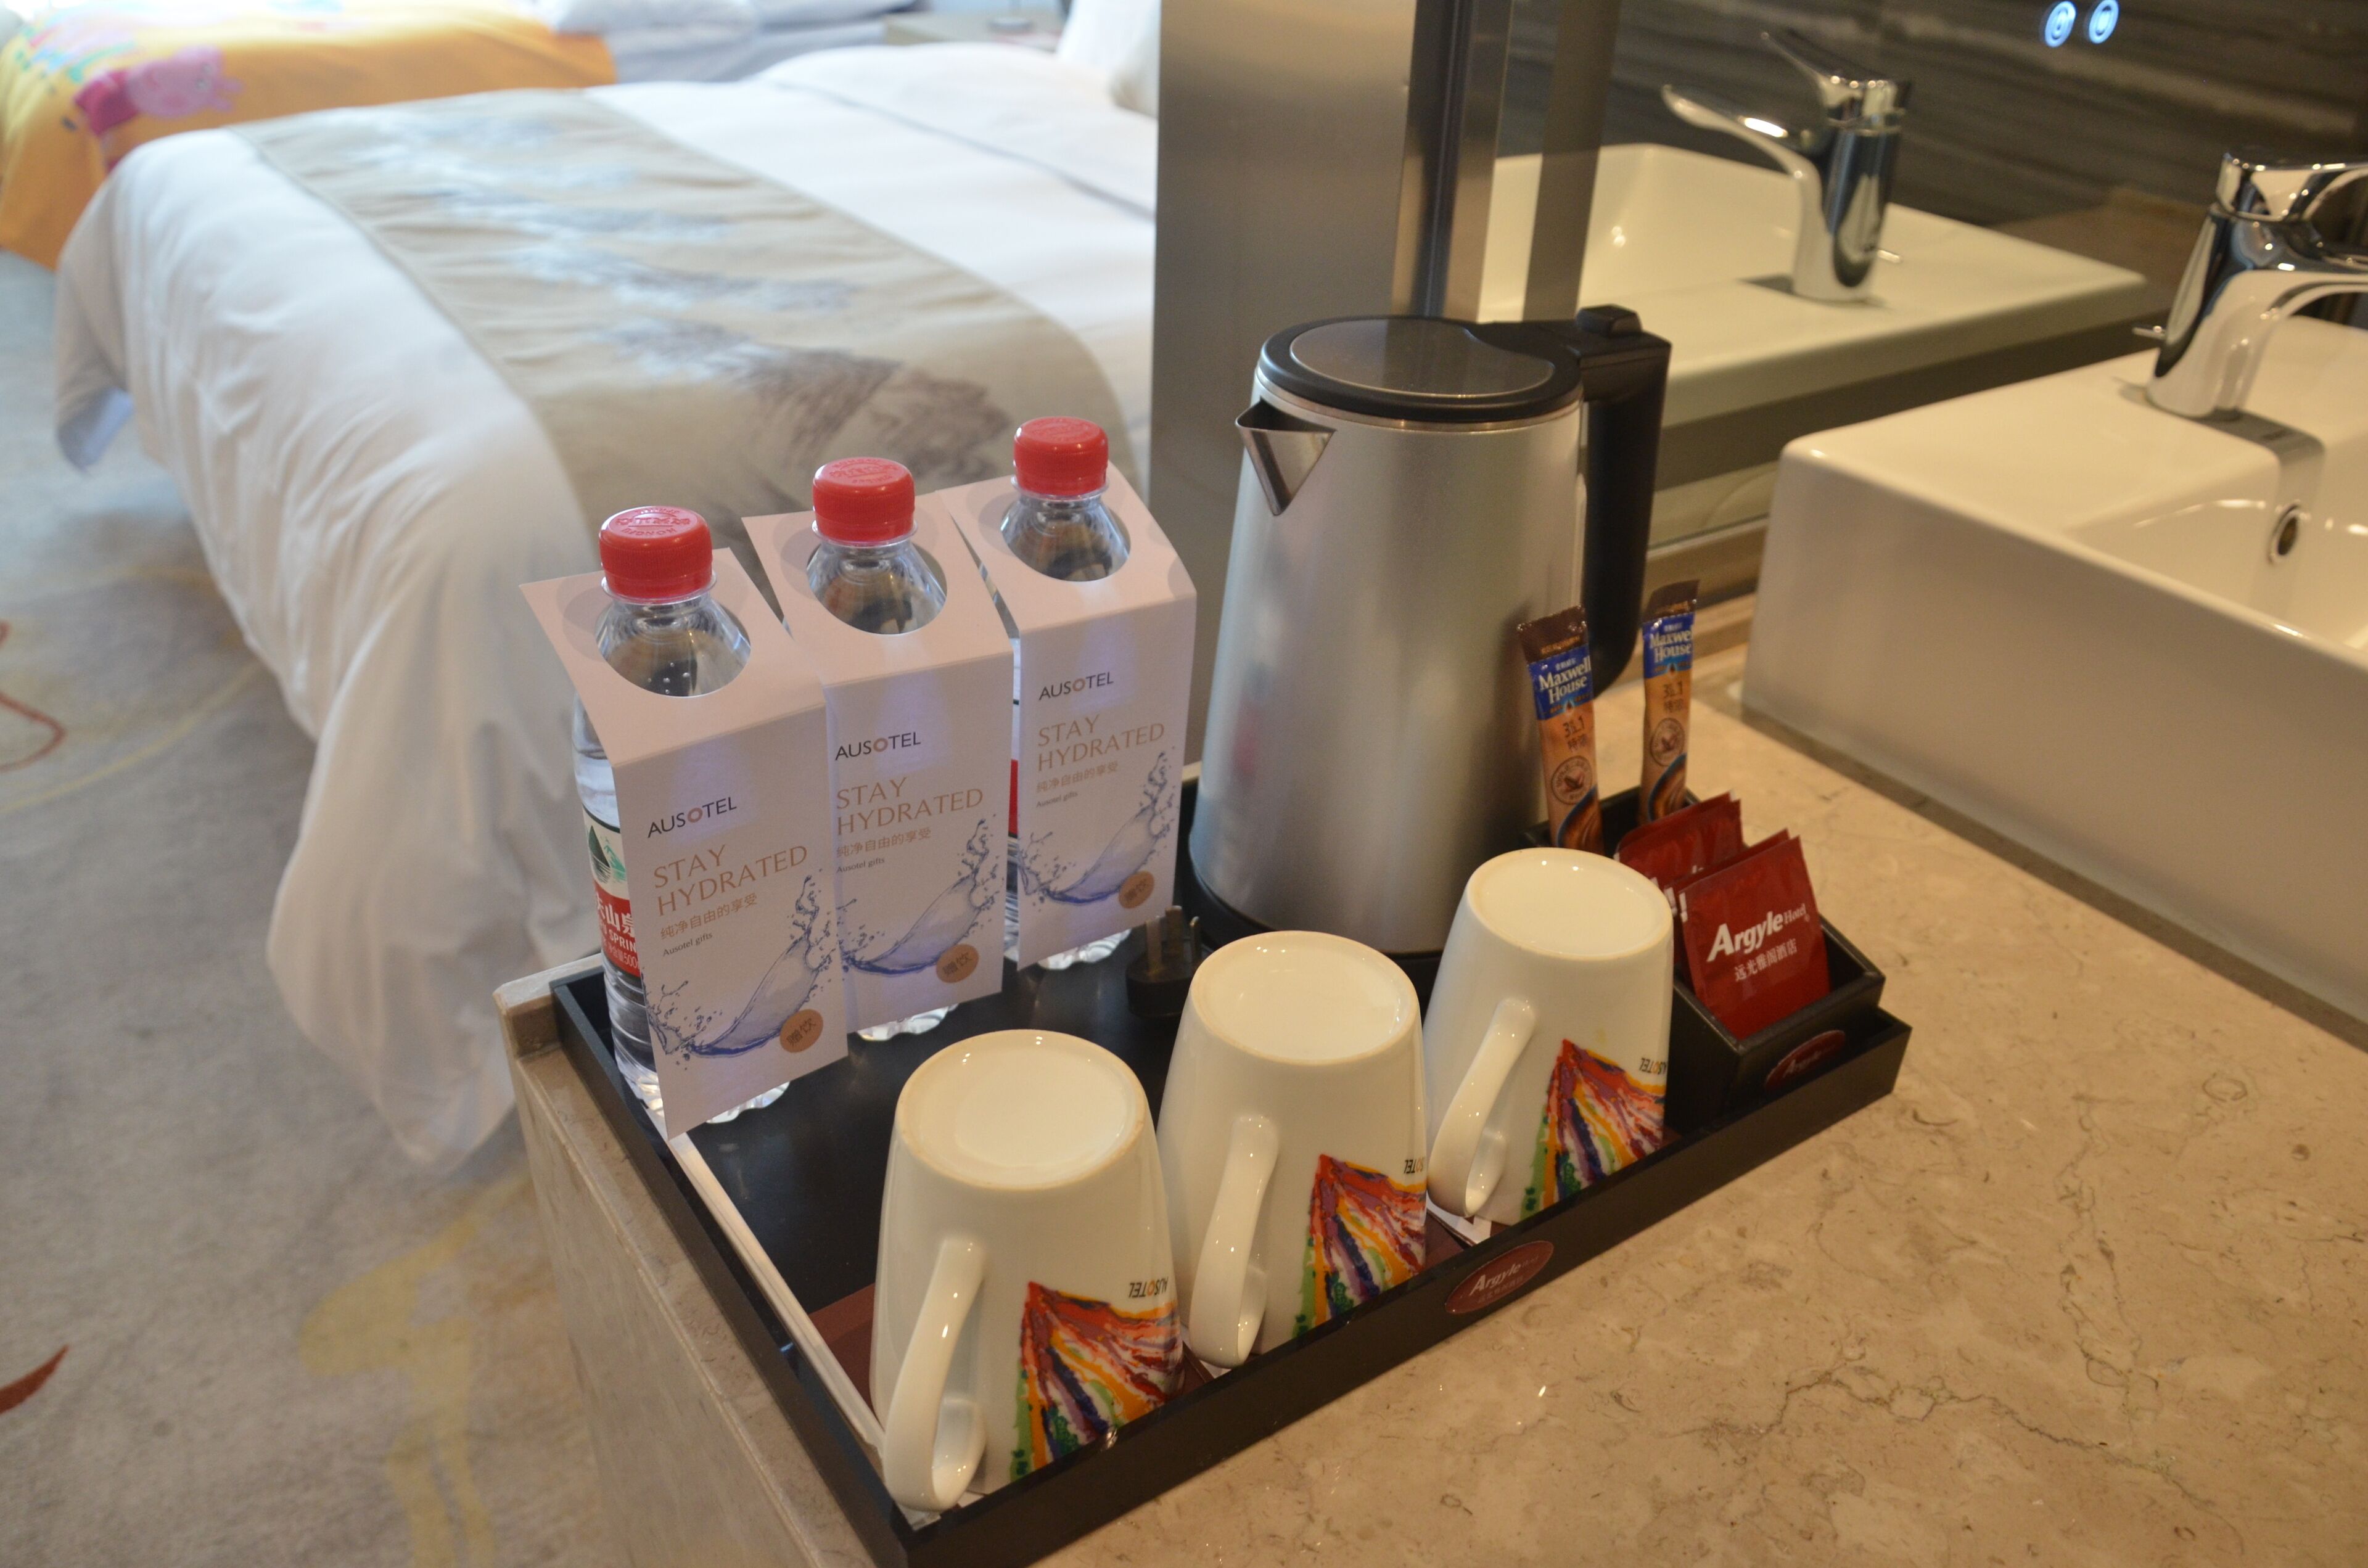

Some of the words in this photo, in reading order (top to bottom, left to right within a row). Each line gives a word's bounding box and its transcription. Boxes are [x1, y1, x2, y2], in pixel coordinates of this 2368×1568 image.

[1654, 643, 1692, 663] House
[1038, 671, 1114, 700] AUSOTEL
[1538, 655, 1591, 691] Maxwell
[1548, 675, 1587, 704] House
[835, 731, 921, 761] AUSOTEL
[1038, 713, 1100, 747] STAY
[1038, 723, 1165, 771] HYDRATED
[836, 776, 907, 810] STAY
[648, 797, 737, 838] AUSOTEL
[837, 788, 984, 836] HYDRATED
[836, 827, 931, 858] 纯净自由的享受
[654, 844, 726, 889] STAY
[657, 845, 807, 916] HYDRATED
[836, 862, 865, 874] Ausotel
[868, 857, 885, 869] gifts
[660, 893, 758, 940] 纯净自由的享受
[663, 938, 693, 956] Ausotel
[696, 932, 713, 946] gifts
[1706, 911, 1784, 963] Argyle
[1734, 938, 1798, 982] 远光雅阁酒店
[1469, 1263, 1521, 1297] Argyle
